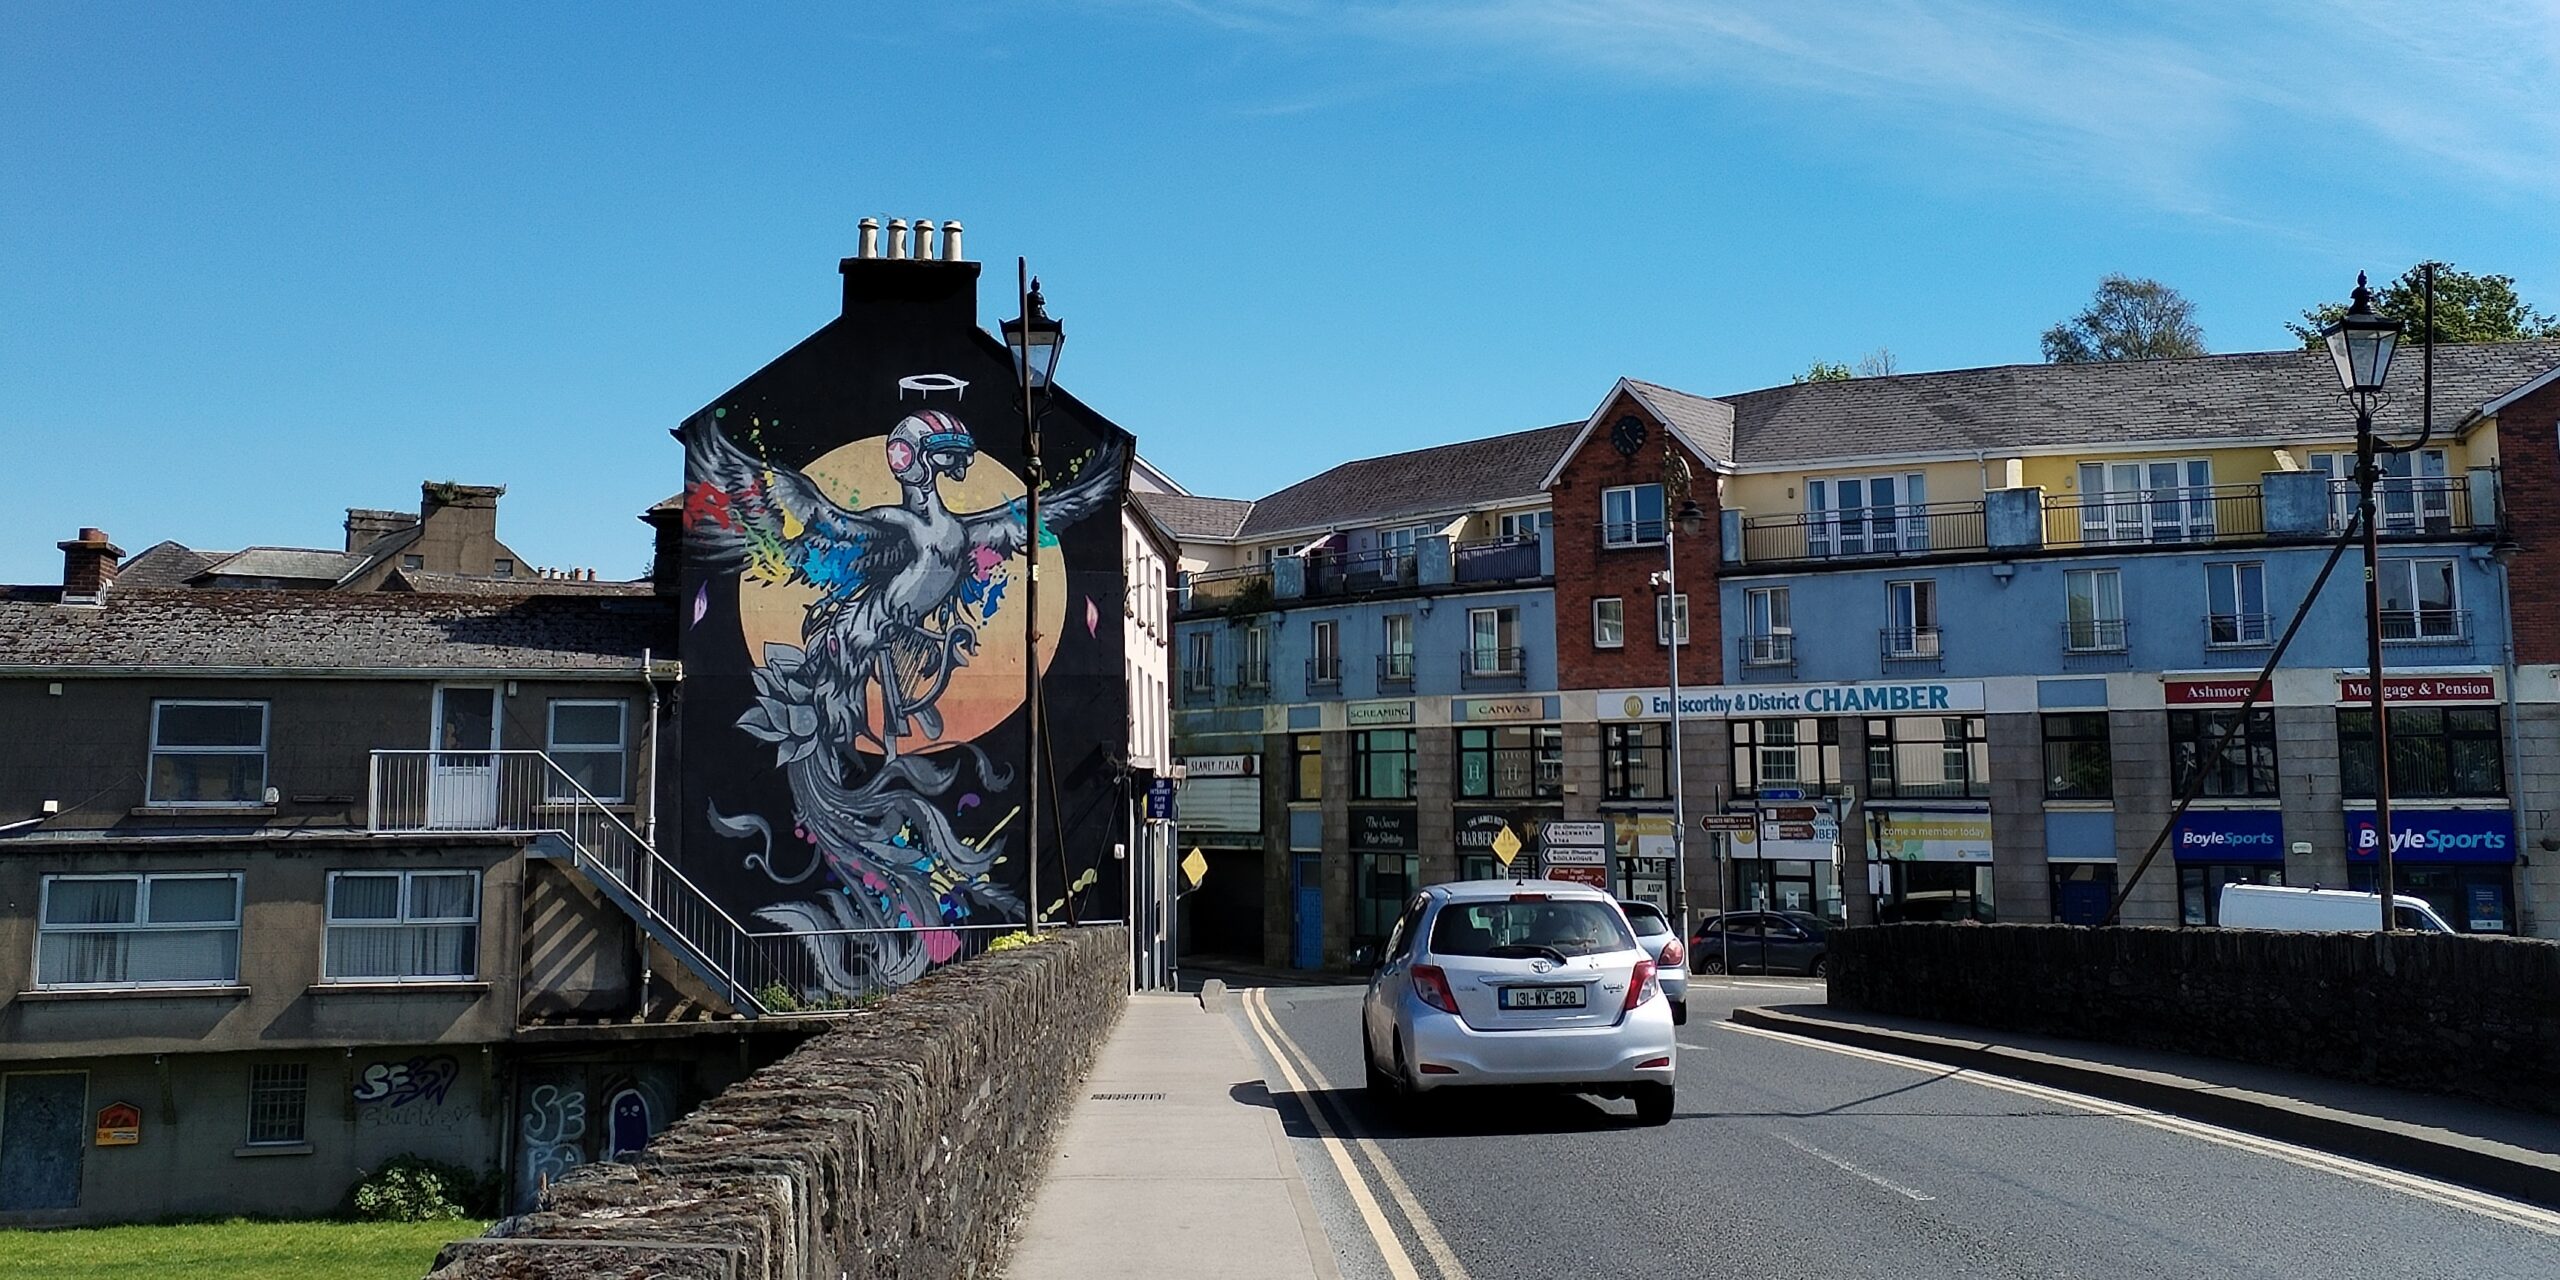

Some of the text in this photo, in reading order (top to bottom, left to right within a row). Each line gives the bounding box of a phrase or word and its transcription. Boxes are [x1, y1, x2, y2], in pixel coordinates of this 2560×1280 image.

[2366, 569, 2372, 580] 3
[2187, 686, 2251, 698] Ashmore
[2349, 682, 2489, 699] Mogage & Pension
[1653, 685, 1949, 714] Eniscorthy & District CHAMBER
[1350, 705, 1530, 718] SCREAMING CANVAS
[1191, 760, 1240, 771] SLANEY PLAZA
[1365, 815, 1379, 828] The
[1881, 827, 1909, 837] come
[1919, 827, 1958, 836] member
[1960, 826, 1985, 838] today
[2183, 831, 2274, 848] BoyleSports
[1515, 991, 1577, 1006] 131-WX-828
